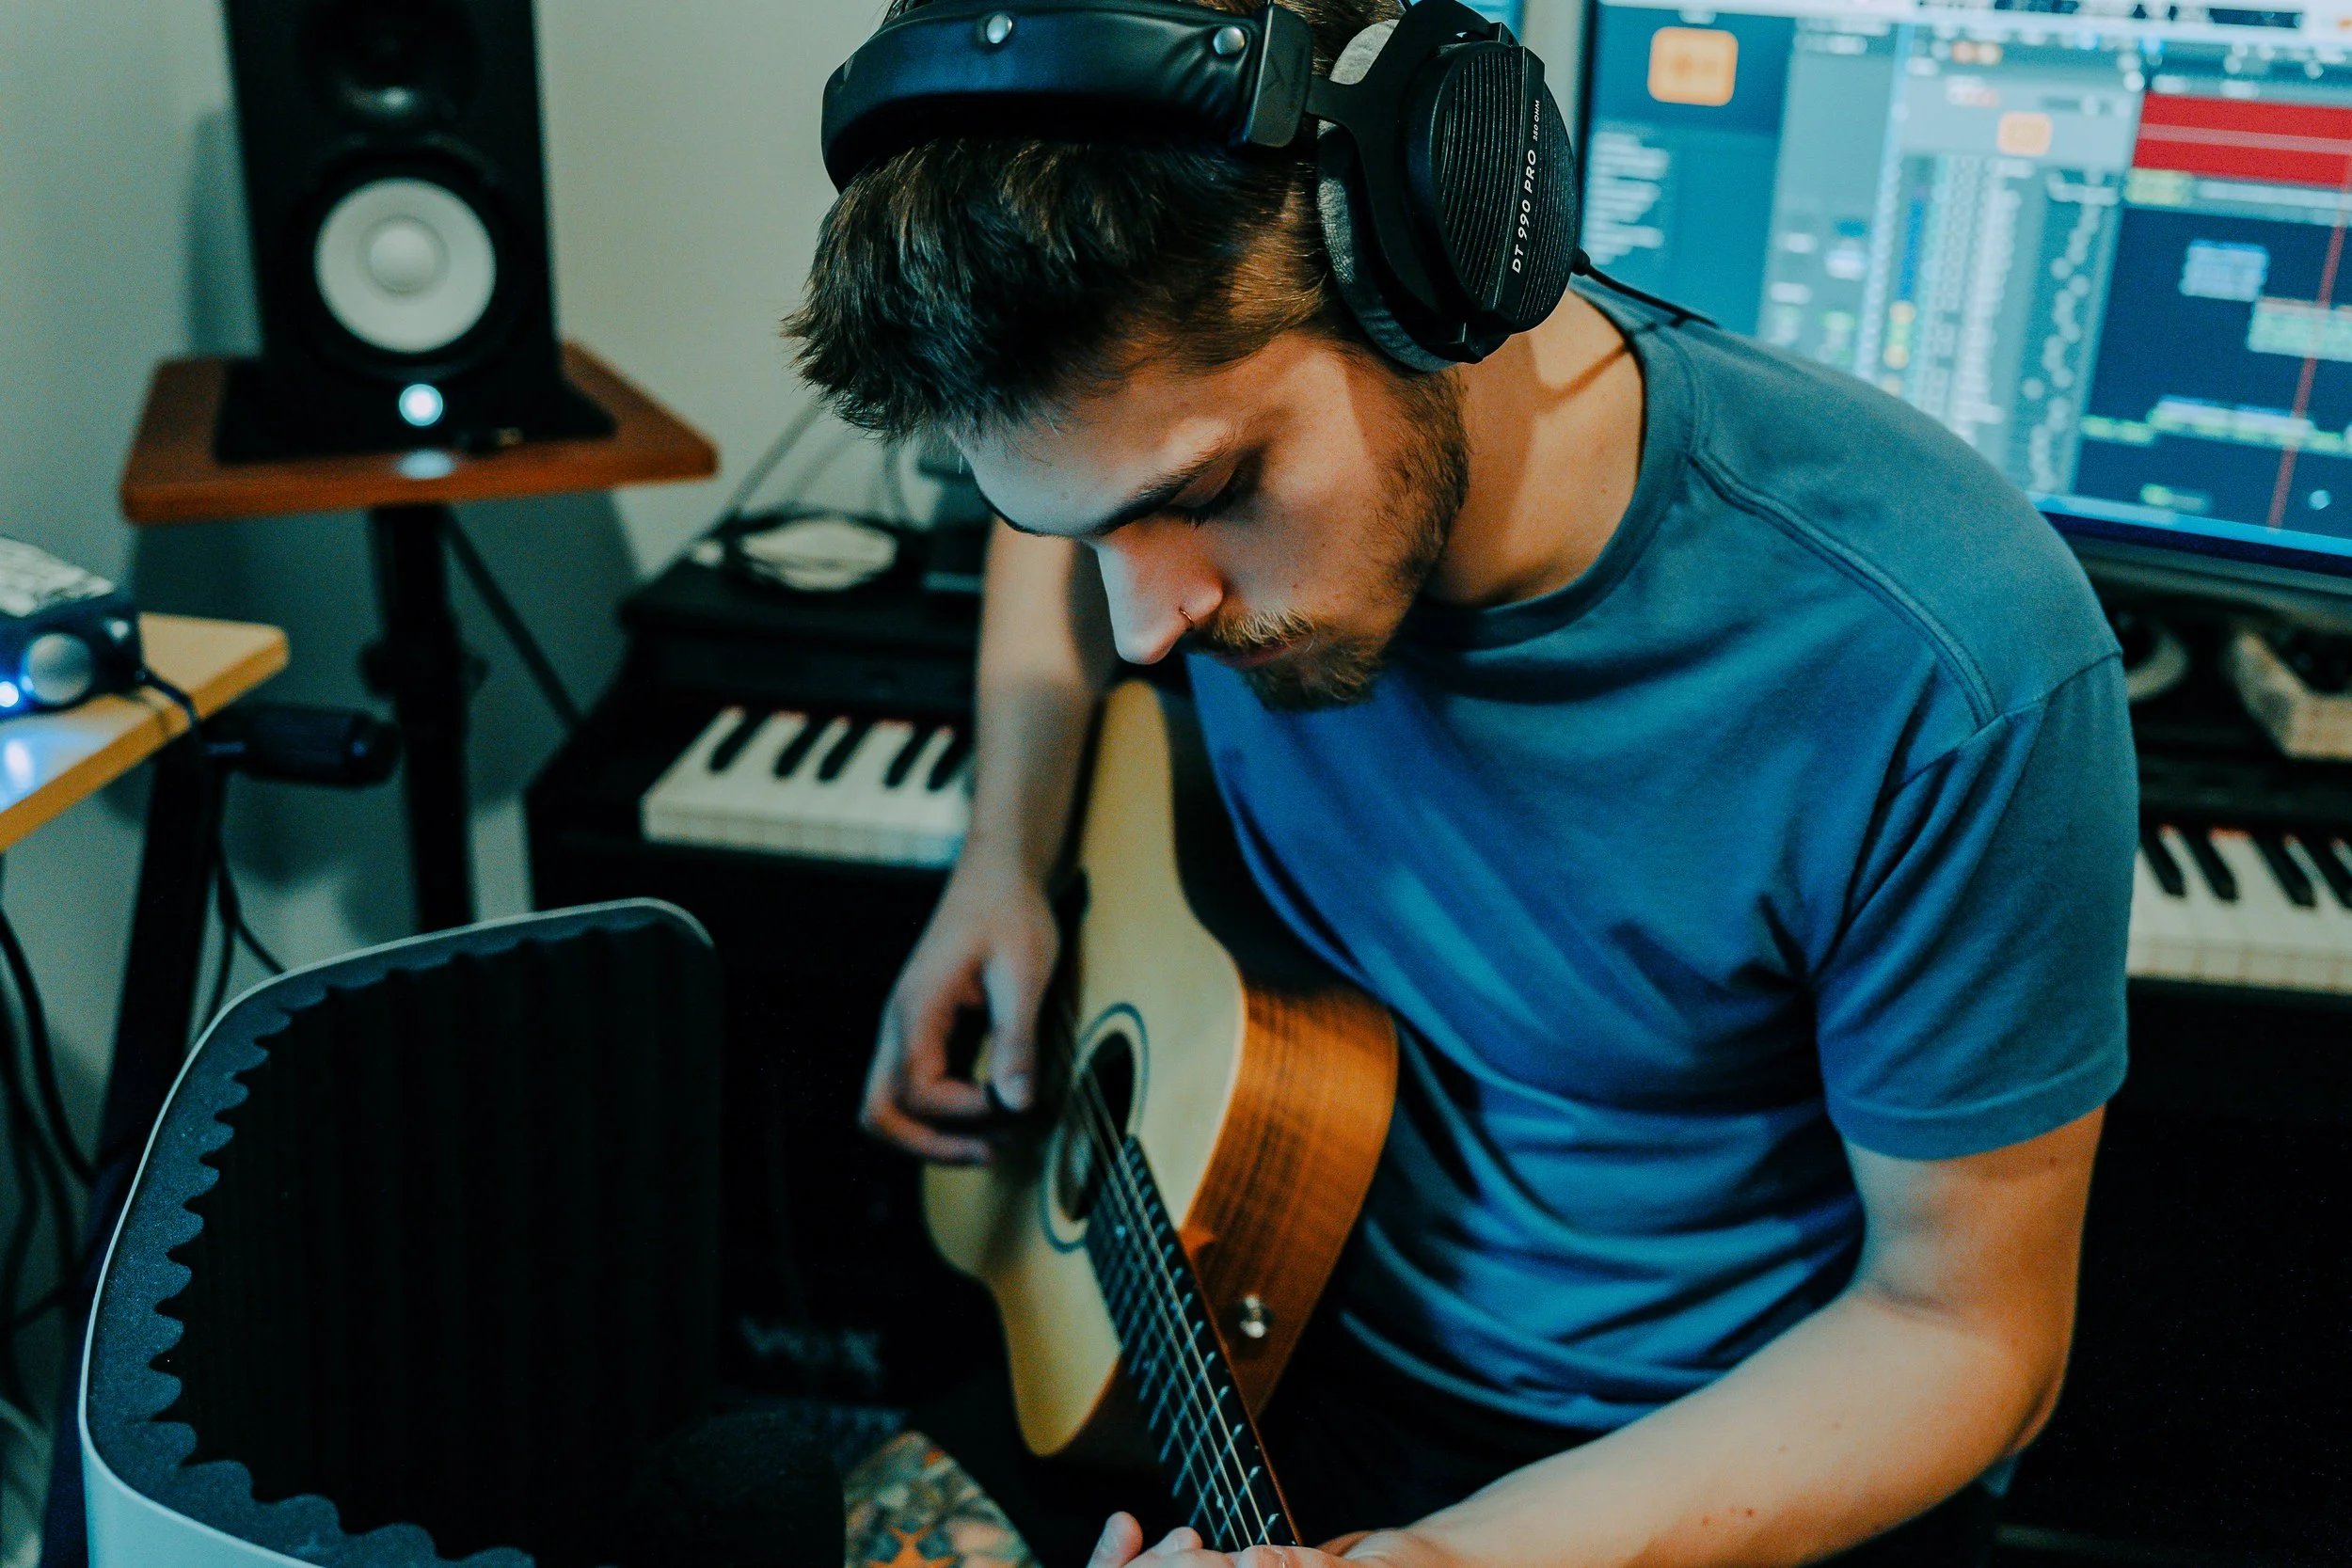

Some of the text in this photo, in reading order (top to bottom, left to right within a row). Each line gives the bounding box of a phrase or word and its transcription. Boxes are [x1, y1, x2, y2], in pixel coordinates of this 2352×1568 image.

[1523, 149, 1536, 194] PRO
[1518, 199, 1532, 241] 990
[1512, 244, 1524, 274] DT
